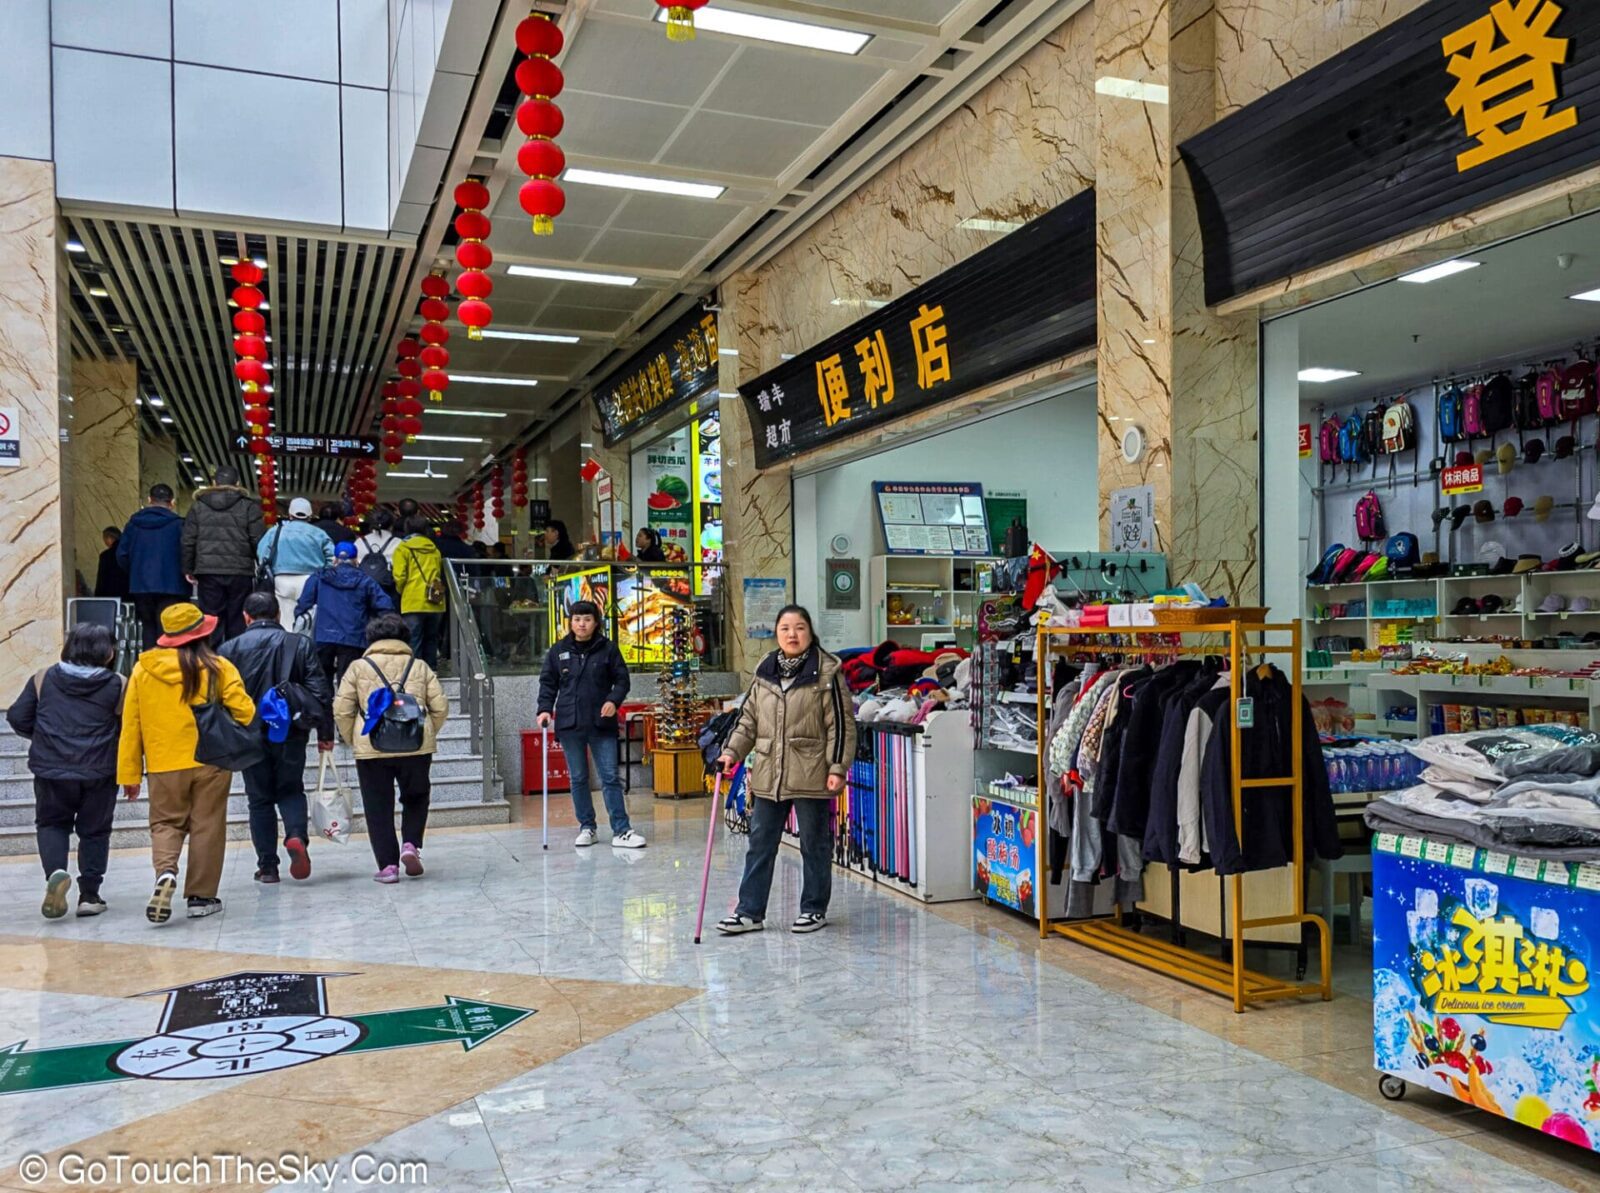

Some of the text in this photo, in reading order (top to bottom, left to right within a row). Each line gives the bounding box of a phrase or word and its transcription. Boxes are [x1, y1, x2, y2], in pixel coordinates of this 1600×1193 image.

[1441, 0, 1577, 173] 登
[815, 304, 951, 427] 便利店
[757, 383, 785, 412] 瑞丰
[766, 418, 792, 448] 超市
[1445, 468, 1479, 486] 休闲食品
[1421, 907, 1590, 998] 冰淇淋
[1441, 997, 1526, 1011] Delicious ice cream
[305, 1026, 350, 1041] 西
[215, 1056, 265, 1071] 北
